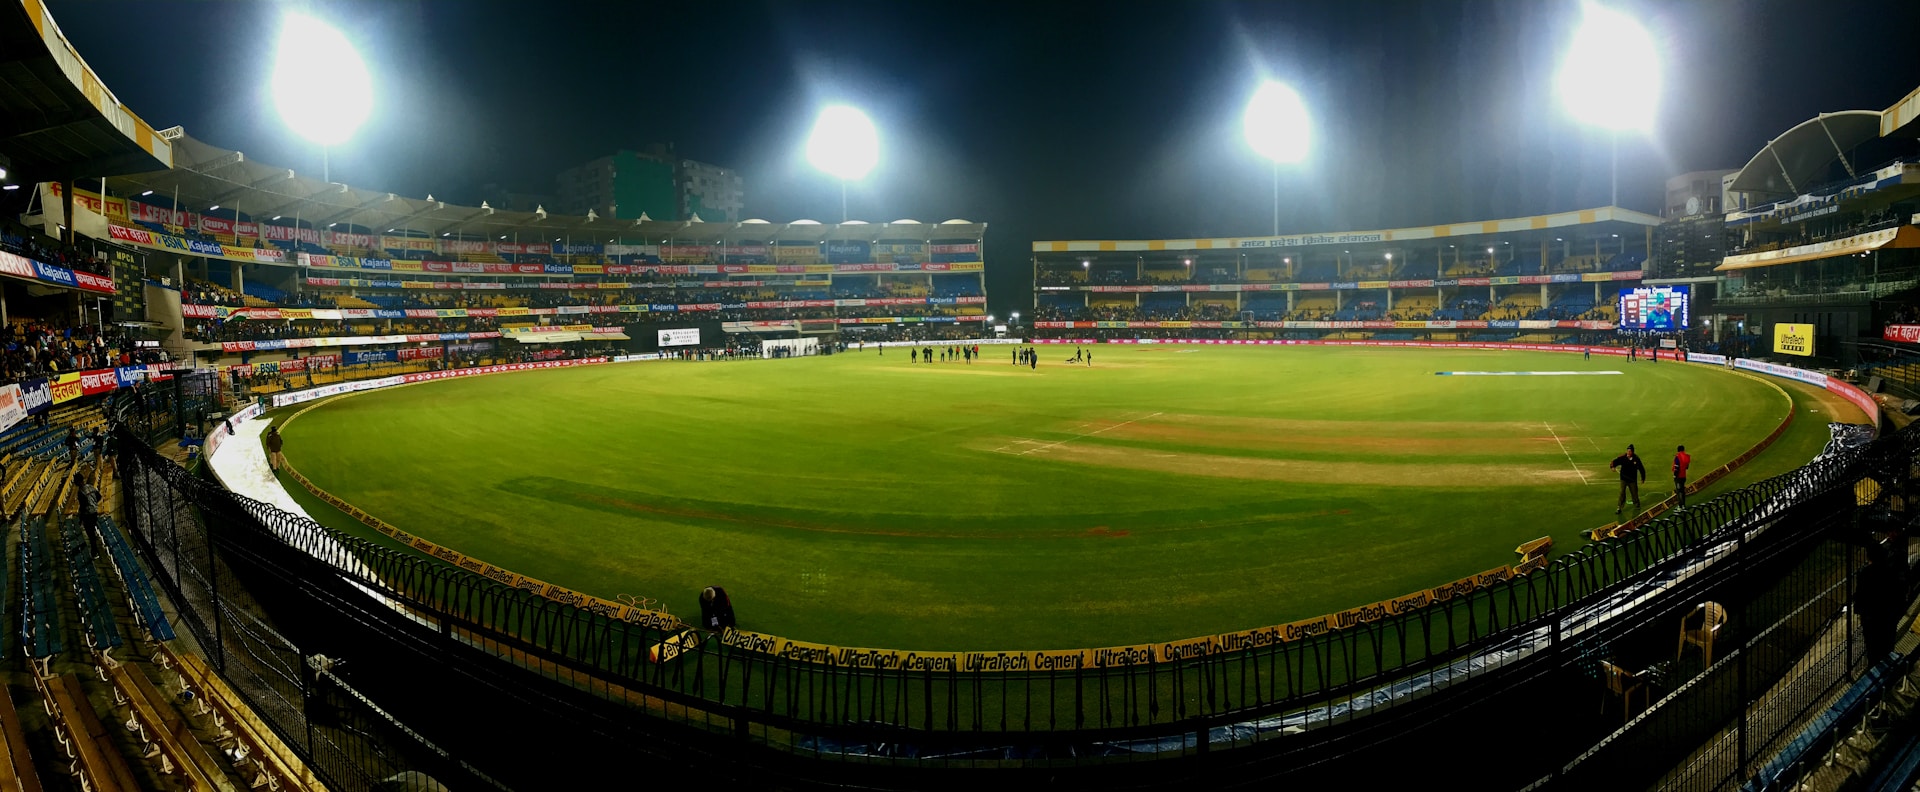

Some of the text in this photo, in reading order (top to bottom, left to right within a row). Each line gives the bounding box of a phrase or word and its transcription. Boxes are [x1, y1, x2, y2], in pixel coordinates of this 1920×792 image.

[145, 205, 184, 226] SERVO
[204, 220, 229, 231] RUPA
[265, 225, 319, 242] PAN BAHAR
[335, 233, 369, 247] SERVO
[161, 233, 187, 251] BSNL
[187, 239, 221, 253] Kajaria
[1242, 234, 1381, 248] मध्य प्रदेश क्रिकेट संगठन
[116, 251, 134, 263] MPCA
[256, 249, 282, 258] RALCO
[361, 258, 390, 269] Kajaria
[545, 264, 572, 273] Kajaria
[37, 261, 72, 282] Kajaria
[182, 304, 196, 316] PAN
[652, 303, 674, 311] Kajaria
[783, 300, 804, 308] SERVO
[378, 310, 401, 318] Kajaria
[357, 351, 387, 363] Kajaria
[260, 363, 279, 373] BSNL
[51, 380, 82, 400] दिलबाग
[414, 539, 434, 553] Cement
[434, 546, 459, 564] UltraTech
[460, 556, 483, 573] Cement
[484, 564, 514, 584] UltraTech
[516, 576, 545, 594] Cement
[547, 585, 584, 608] UltraTech
[588, 598, 621, 619] Cement
[1337, 602, 1386, 628] UltraTech
[625, 607, 673, 631] UltraTech
[1287, 616, 1328, 640] Cement
